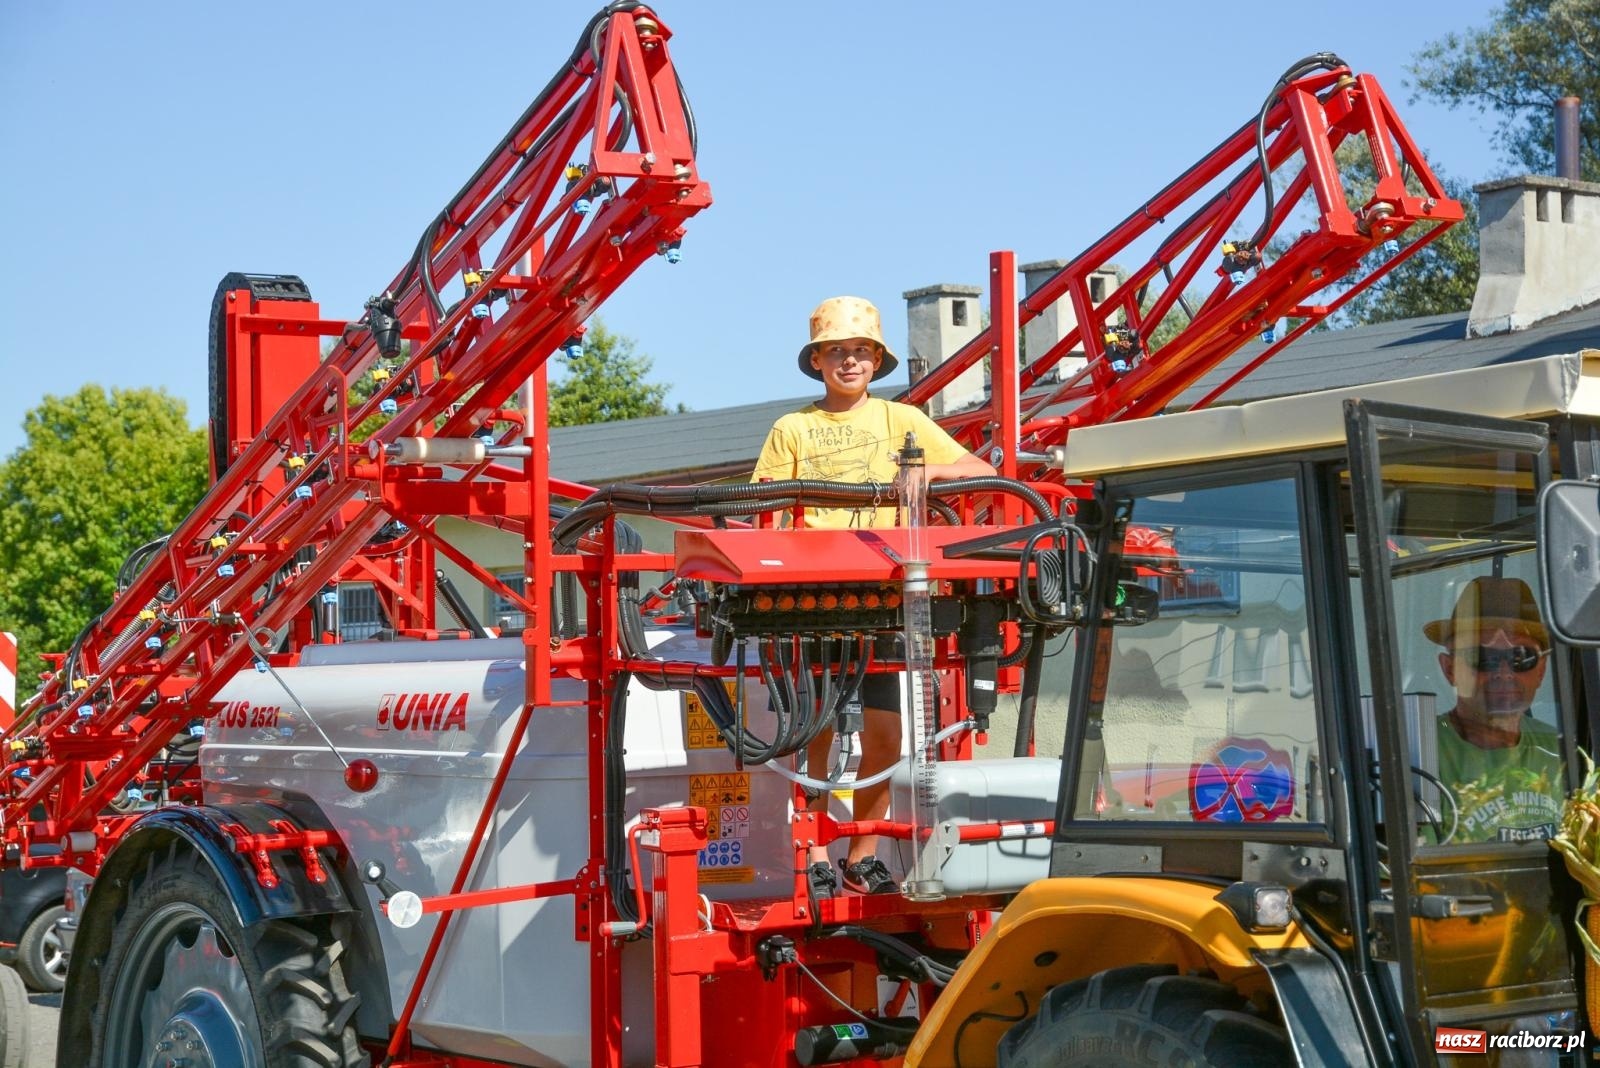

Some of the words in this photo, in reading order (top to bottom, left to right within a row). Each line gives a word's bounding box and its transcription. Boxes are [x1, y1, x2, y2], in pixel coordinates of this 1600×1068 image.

[808, 425, 853, 439] THATS
[819, 438, 842, 447] HOW
[250, 706, 280, 728] 2521
[393, 692, 469, 731] UNIA
[1464, 796, 1510, 832] PURE
